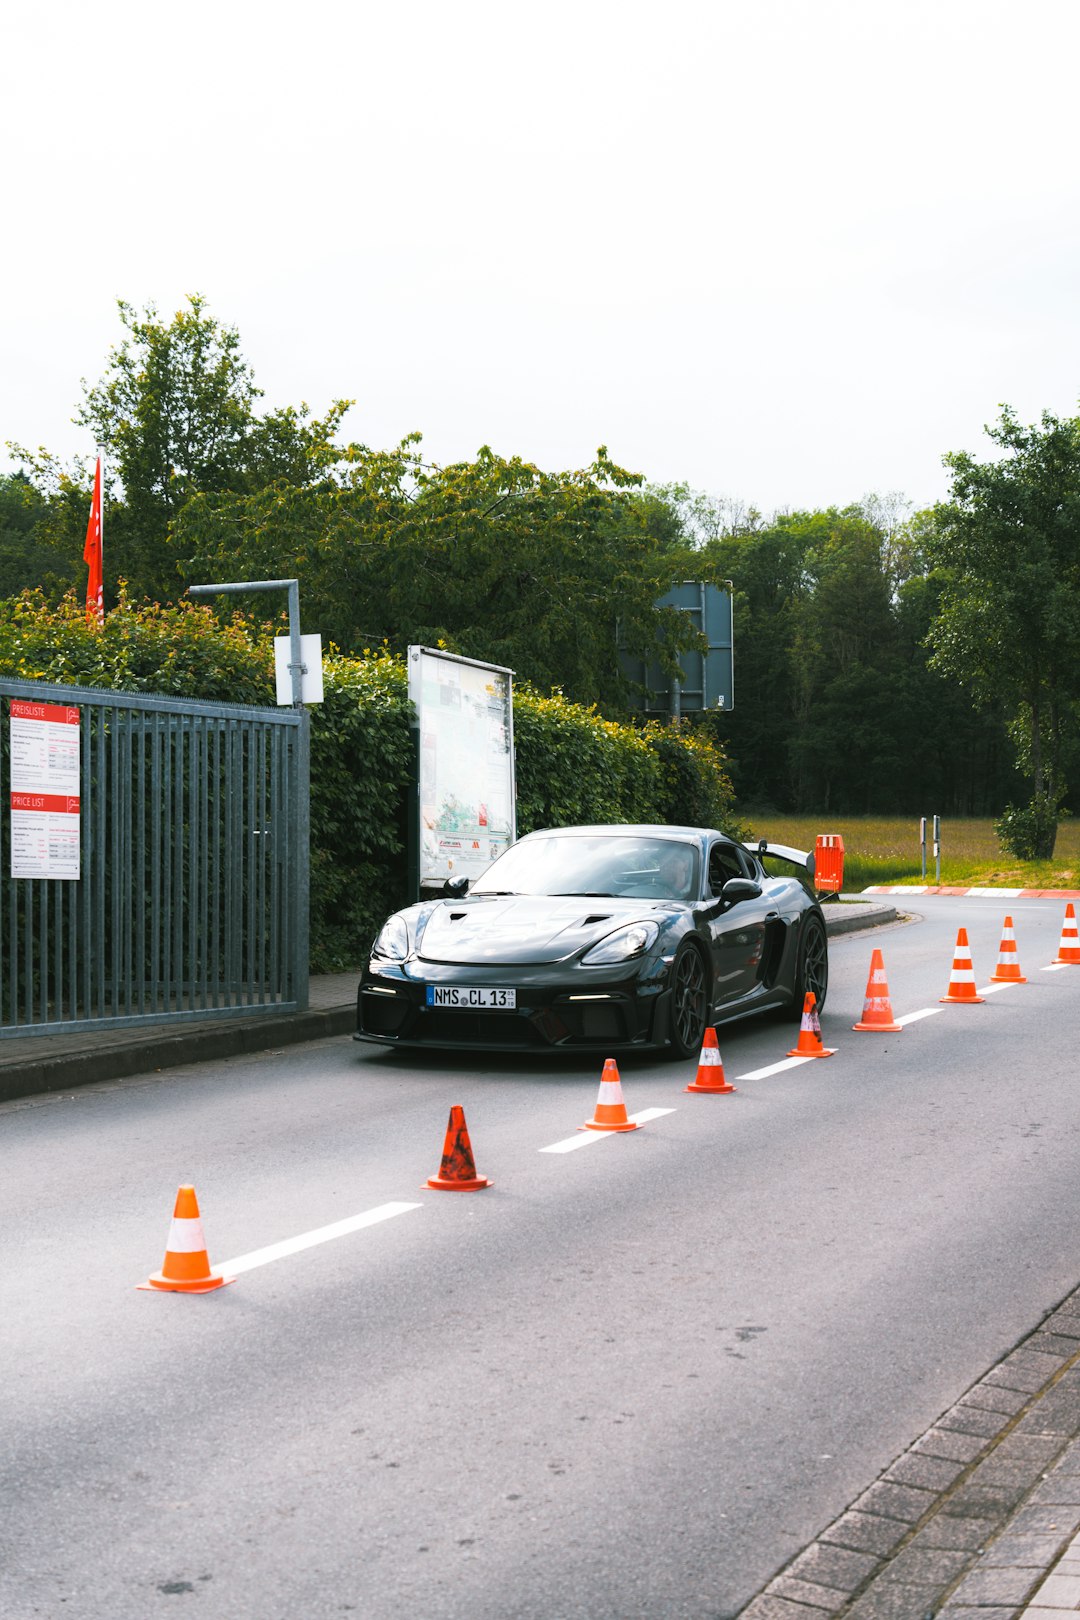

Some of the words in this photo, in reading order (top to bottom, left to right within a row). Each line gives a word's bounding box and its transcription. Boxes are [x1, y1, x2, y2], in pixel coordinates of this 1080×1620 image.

[12, 704, 45, 717] PREISLISTE
[13, 796, 31, 807] PRICE
[32, 798, 45, 807] LIST
[435, 989, 459, 1005] NMS
[469, 990, 486, 1005] CL
[490, 991, 507, 1006] 13
